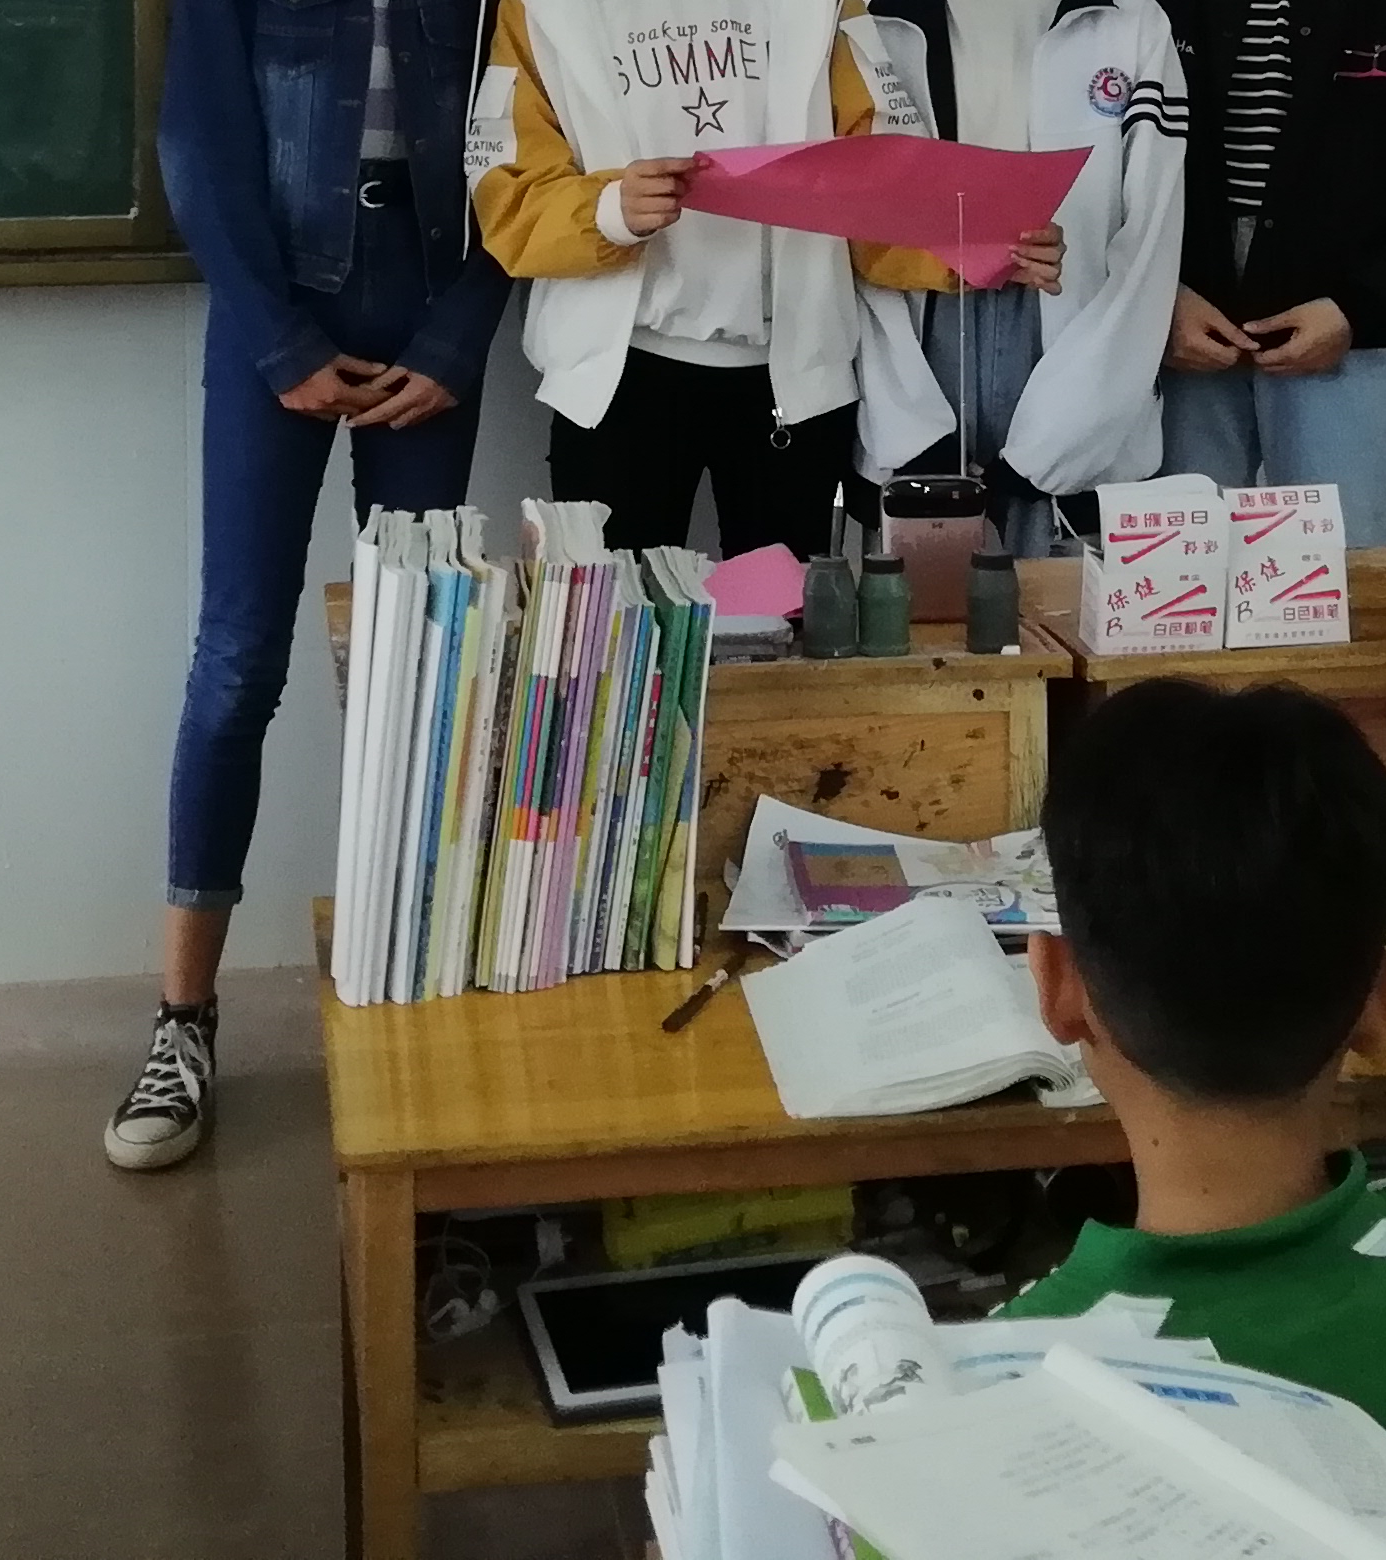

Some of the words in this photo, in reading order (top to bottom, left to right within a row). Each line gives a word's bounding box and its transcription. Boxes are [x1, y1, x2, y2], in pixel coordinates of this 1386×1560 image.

[710, 18, 753, 35] some
[612, 36, 771, 96] SUMME
[1233, 555, 1286, 596] 保健
[1106, 575, 1161, 613] 保健
[1282, 603, 1340, 622] 白色粉笔
[1152, 620, 1214, 638] 白色粉笔
